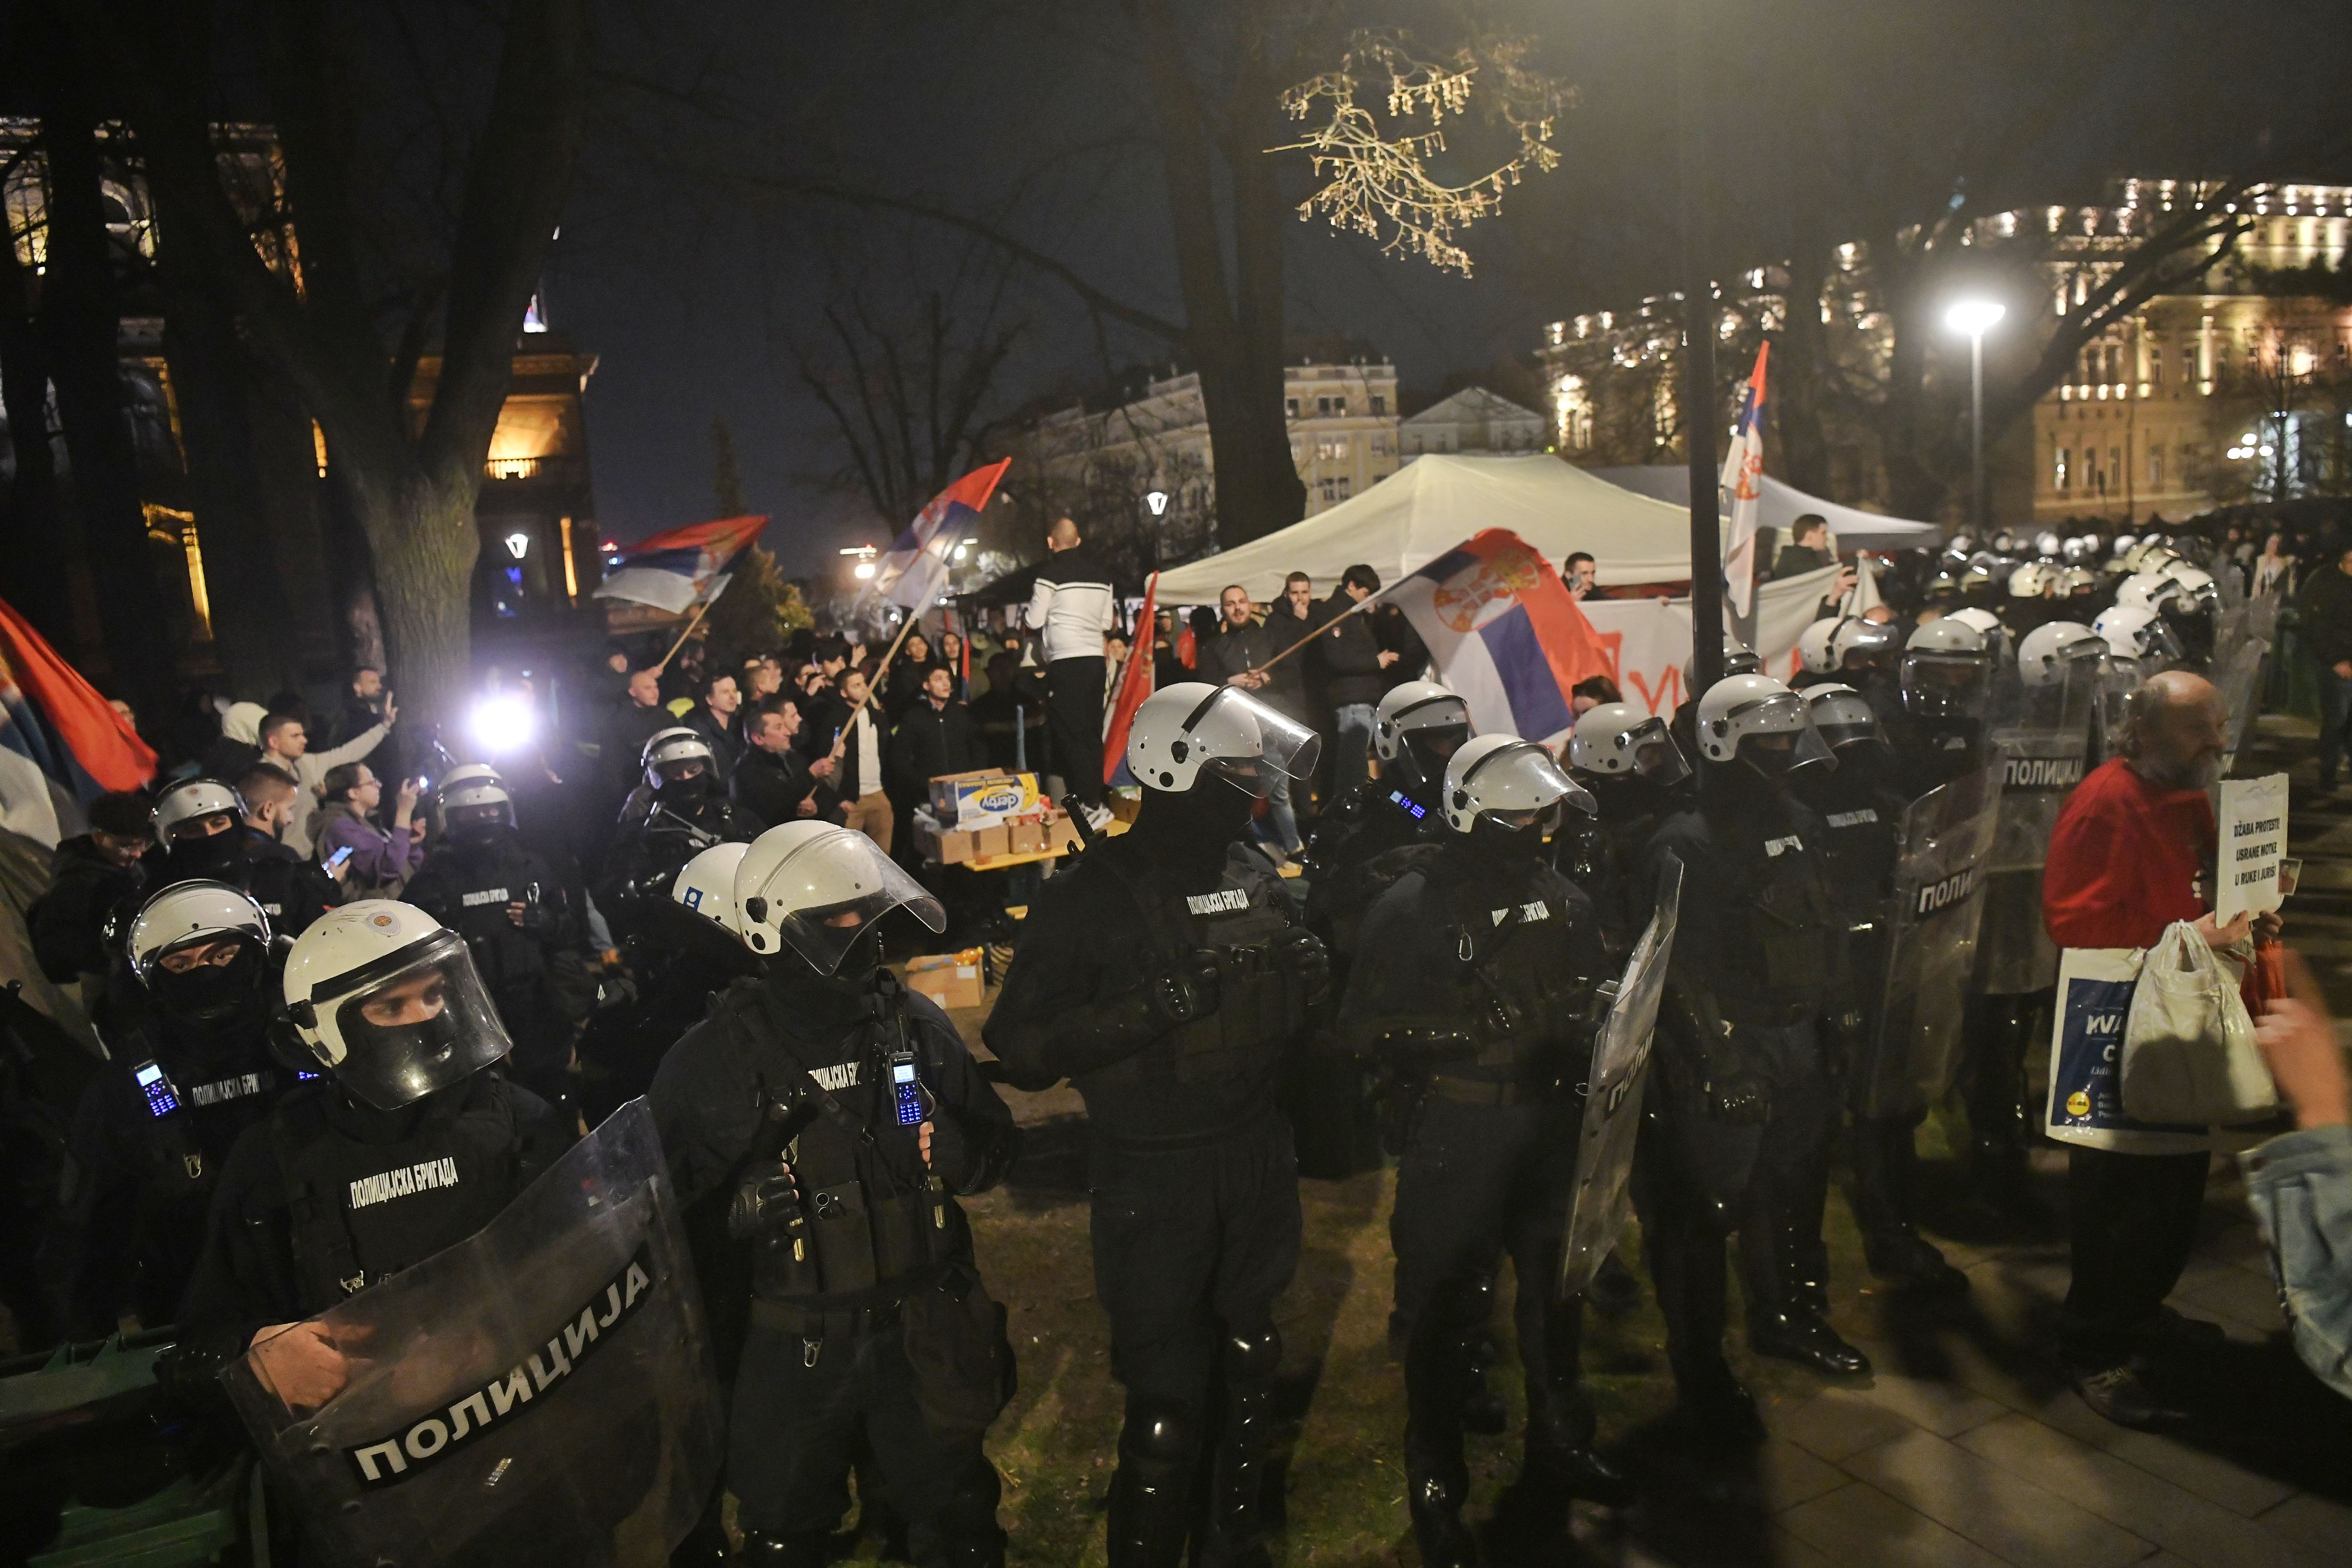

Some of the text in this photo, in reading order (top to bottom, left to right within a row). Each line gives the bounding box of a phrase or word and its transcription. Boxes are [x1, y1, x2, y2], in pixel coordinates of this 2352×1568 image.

[983, 794, 1017, 810] derby
[2261, 842, 2277, 856] MOTKE
[1919, 870, 1973, 913] ПОЛИ
[2235, 874, 2239, 886] U
[2241, 870, 2257, 885] RUKE
[1609, 1027, 1655, 1111] ПОЛИ
[350, 1156, 459, 1209] ПОЛИЦИЈСКА БРИГАДА
[355, 1261, 649, 1481] ПОЛИЦИЈА
